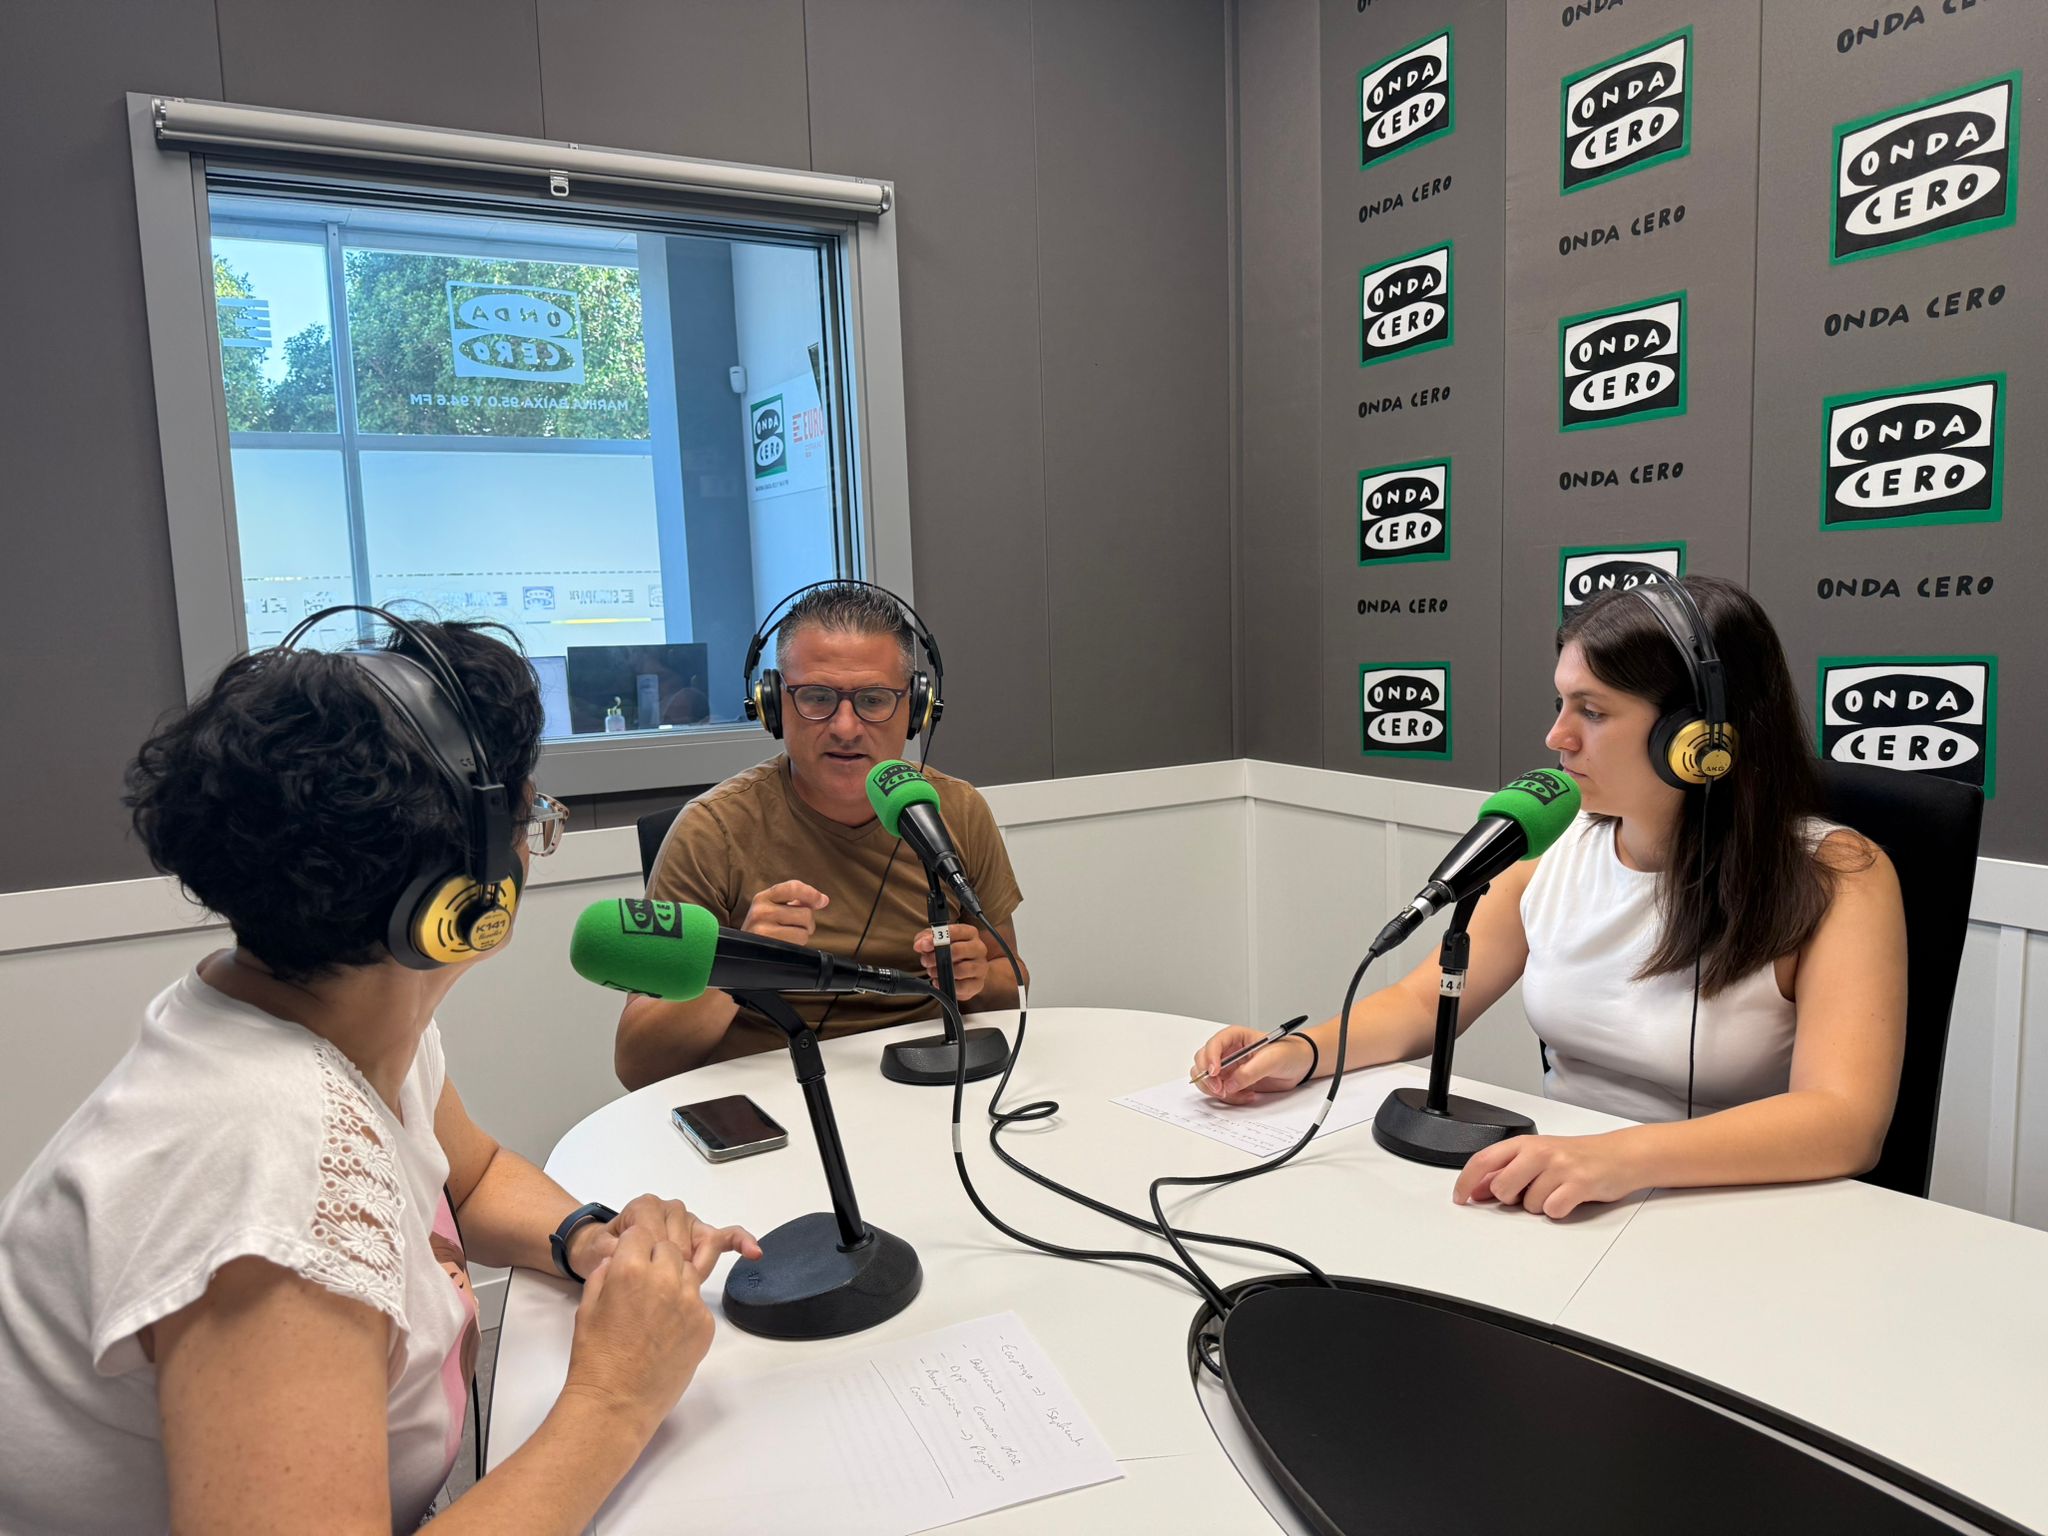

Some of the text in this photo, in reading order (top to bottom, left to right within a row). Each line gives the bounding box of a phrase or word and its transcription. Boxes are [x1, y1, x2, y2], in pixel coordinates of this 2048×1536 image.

[1836, 5, 1925, 54] ONDA
[1373, 62, 1434, 105] ONDA
[1581, 70, 1665, 119] ONDA
[1376, 97, 1435, 140] CERO
[1584, 113, 1665, 161] CERO
[1860, 122, 1980, 176] ONDA
[1358, 175, 1452, 224] ONDA CERO
[1865, 172, 1979, 225] CERO
[1558, 204, 1686, 256] ONDA CERO
[1373, 272, 1434, 306] ONDA
[1376, 307, 1435, 341] CERO
[1824, 284, 2006, 337] ONDA CERO
[1578, 328, 1660, 363] ONDA
[1358, 386, 1451, 419] ONDA CERO
[1582, 369, 1661, 404] CERO
[756, 414, 779, 436] ONDA
[1850, 414, 1966, 451] ONDA
[760, 441, 780, 461] CERO
[1559, 462, 1684, 491] ONDA CERO
[1854, 464, 1966, 499] CERO
[1372, 486, 1432, 510] ONDA
[1374, 520, 1432, 544] CERO
[1817, 574, 1994, 600] ONDA CERO
[1357, 597, 1448, 615] ONDA CERO
[1373, 686, 1433, 703] ONDA
[1844, 689, 1959, 713] ONDA
[1377, 717, 1433, 737] CERO
[1850, 734, 1959, 762] CERO
[882, 765, 915, 780] OND
[476, 921, 506, 933] K141
